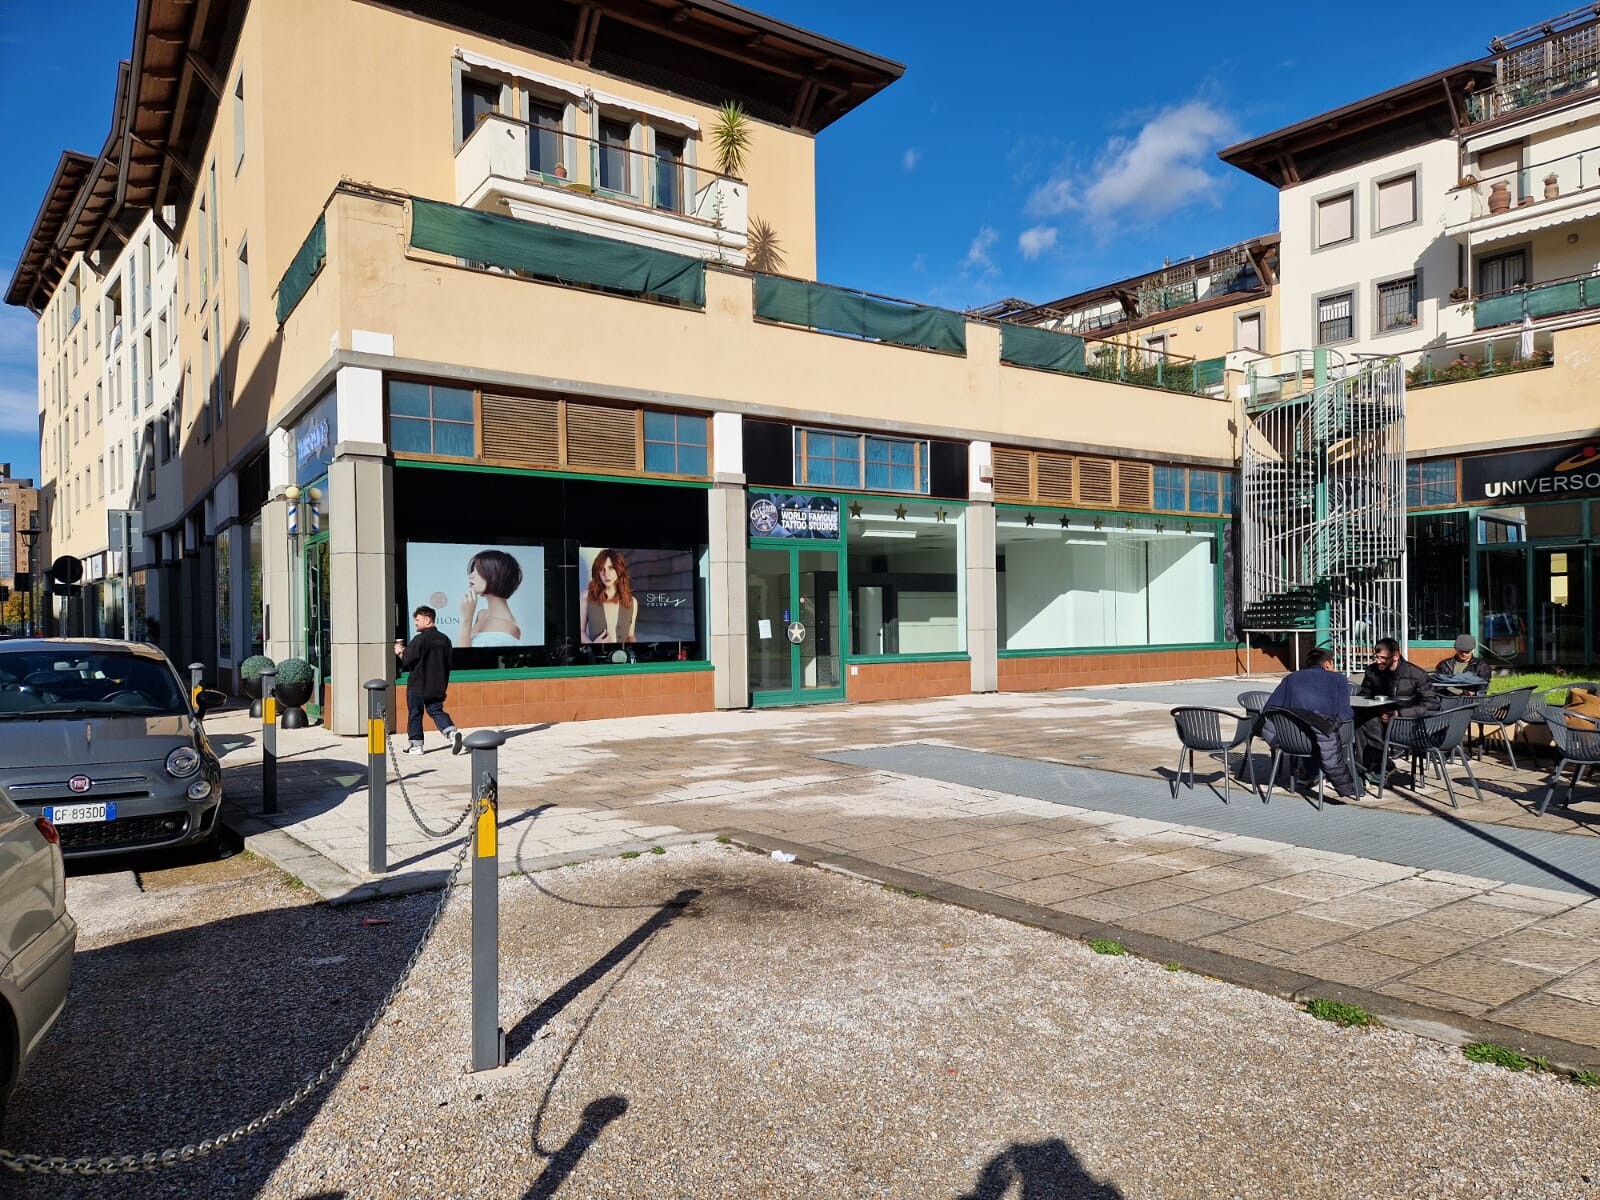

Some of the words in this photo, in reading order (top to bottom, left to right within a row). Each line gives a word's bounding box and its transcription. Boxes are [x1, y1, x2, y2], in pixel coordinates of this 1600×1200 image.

[1484, 473, 1600, 498] UNIVERSO
[781, 511, 807, 521] WORLD
[808, 513, 838, 522] FAMOUS
[782, 520, 807, 530] TATTOO
[808, 521, 838, 531] STUDIOS
